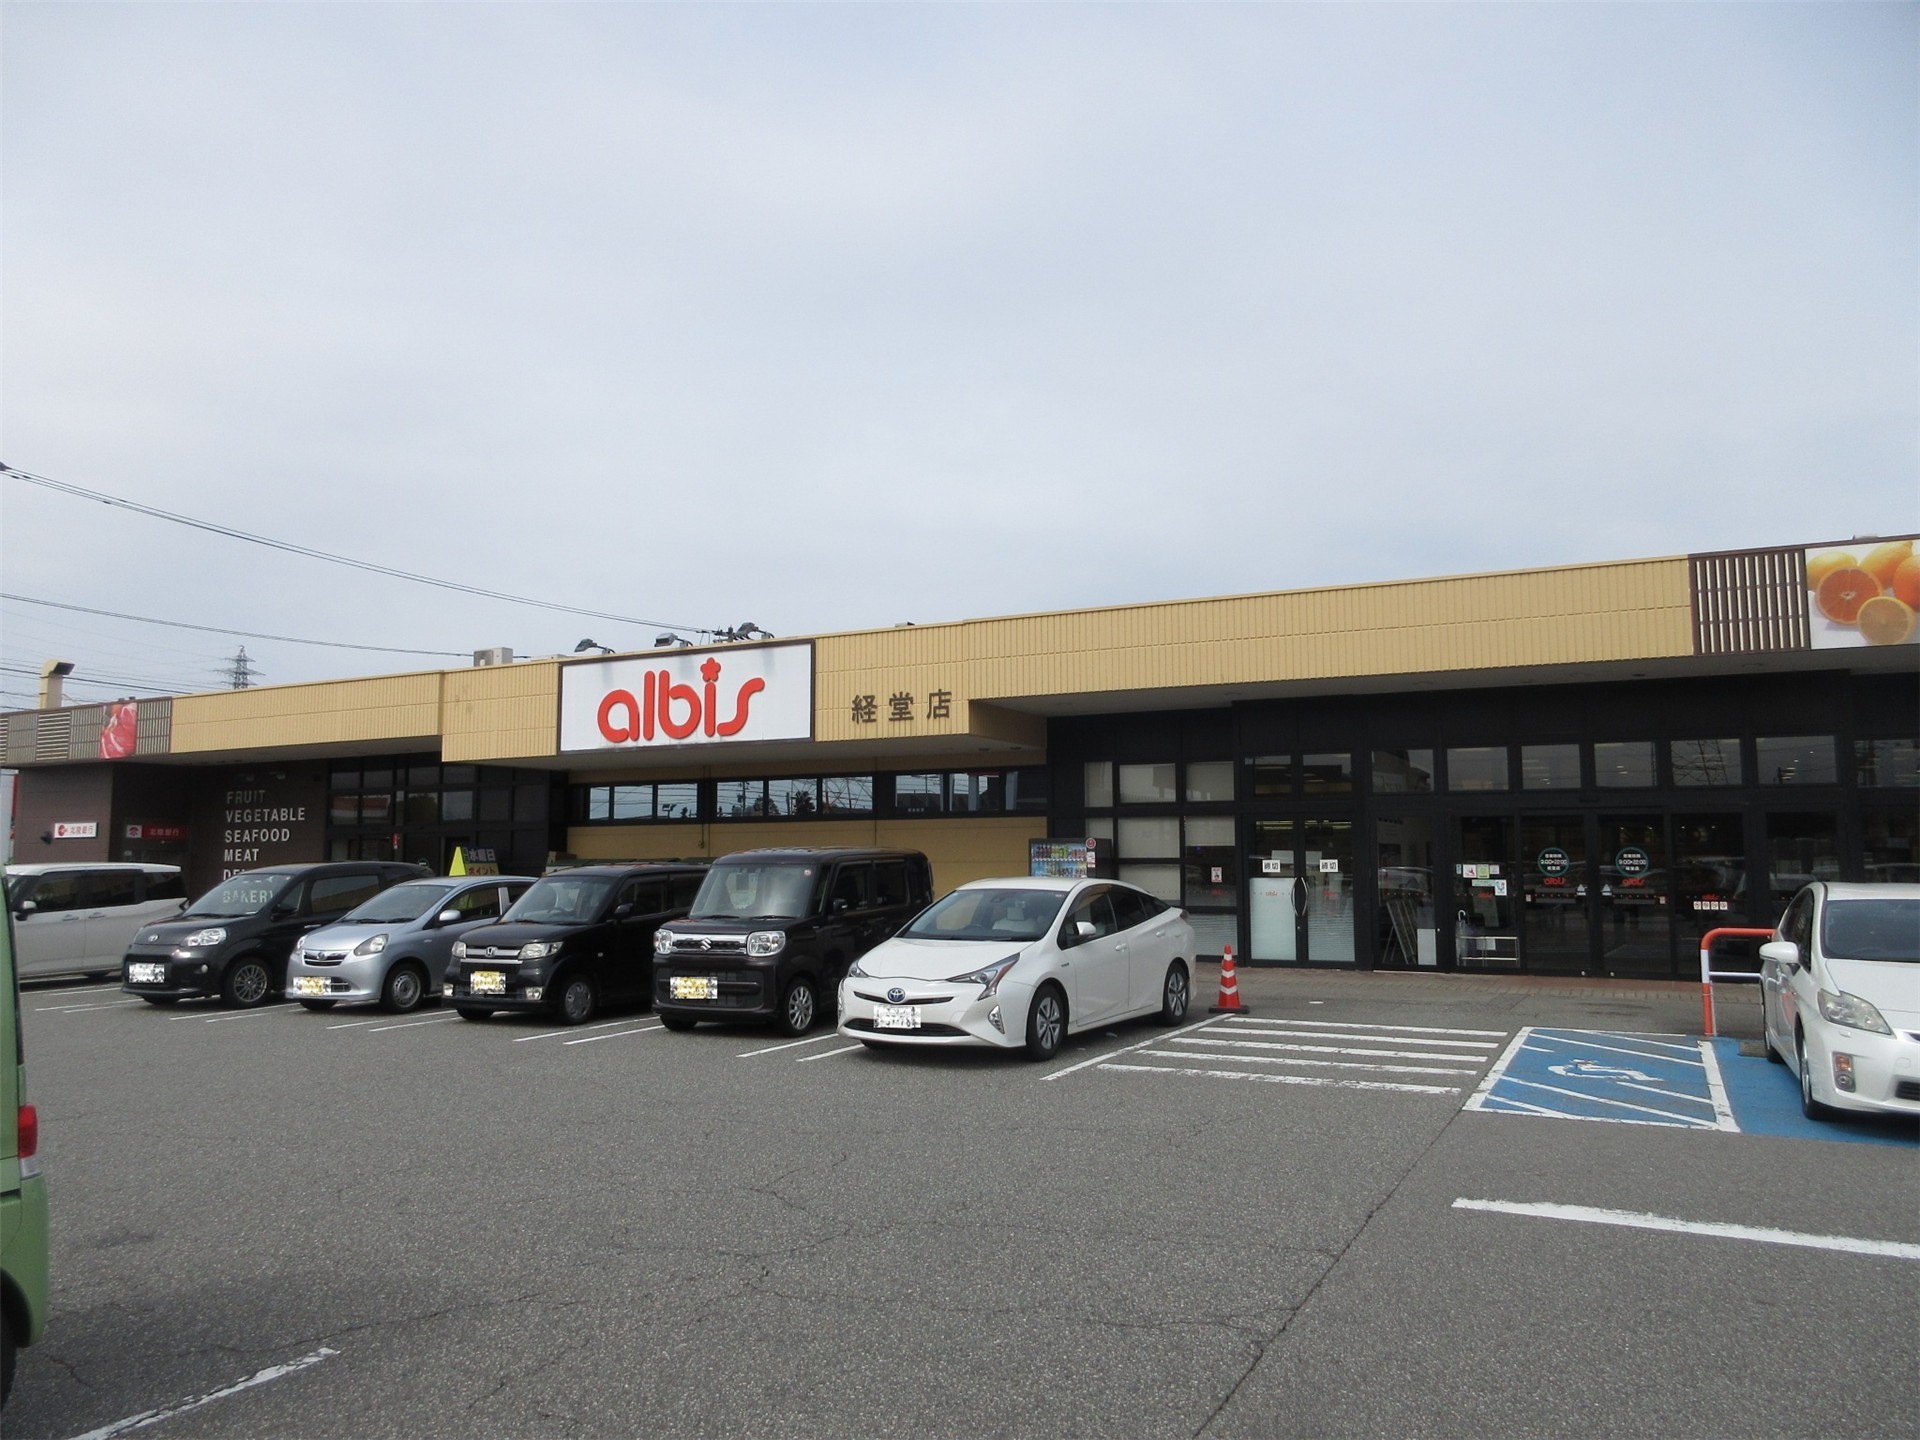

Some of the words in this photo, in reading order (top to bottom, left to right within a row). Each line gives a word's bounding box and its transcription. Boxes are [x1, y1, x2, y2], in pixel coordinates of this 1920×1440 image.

[597, 657, 766, 743] albis
[850, 688, 953, 725] 経堂店
[226, 789, 266, 804] FRUIT
[226, 807, 306, 823] VEGETABLE
[224, 828, 291, 843] SEAFOOD
[224, 849, 260, 862] MEAT
